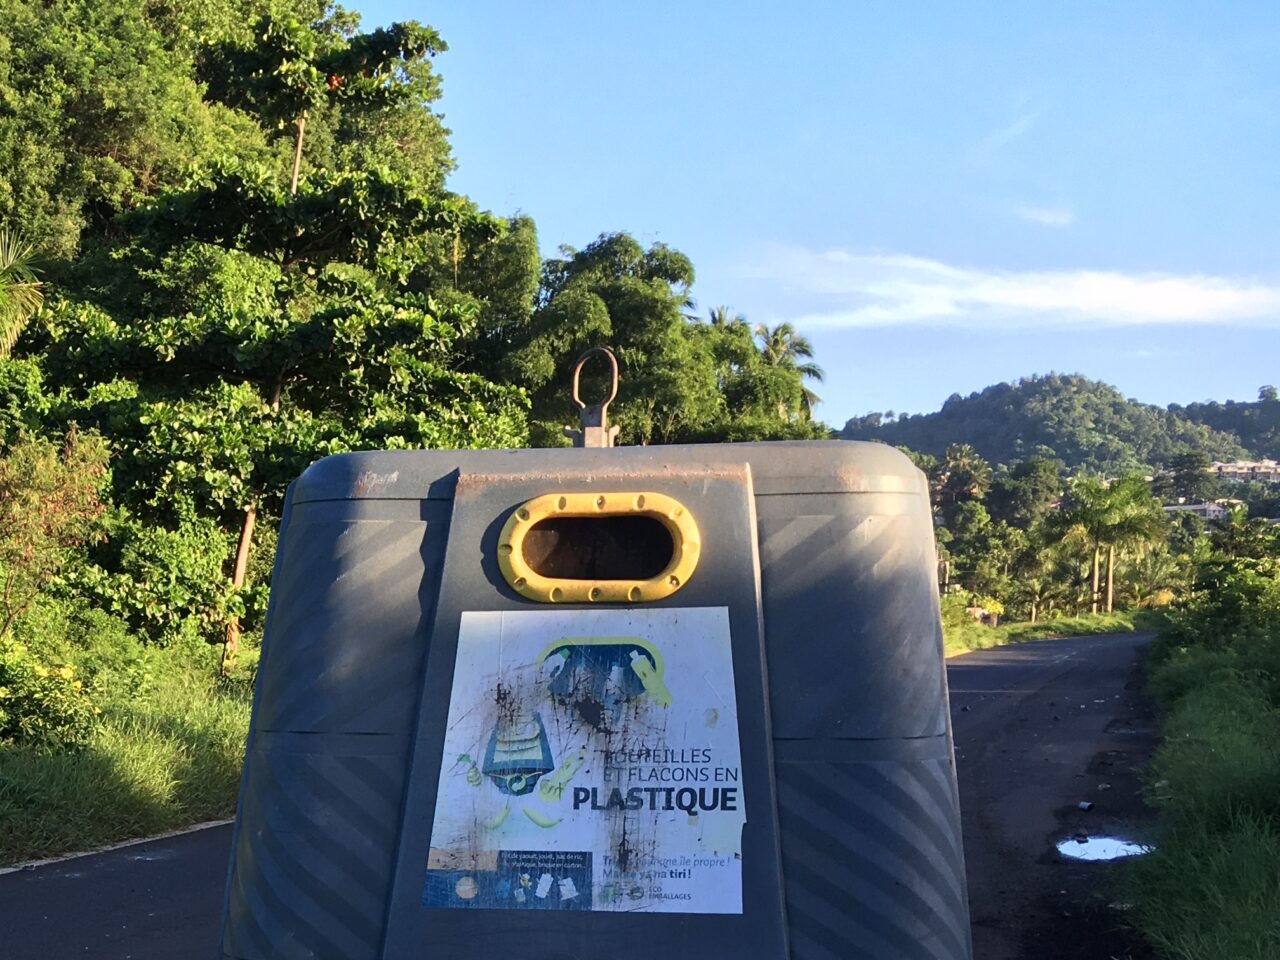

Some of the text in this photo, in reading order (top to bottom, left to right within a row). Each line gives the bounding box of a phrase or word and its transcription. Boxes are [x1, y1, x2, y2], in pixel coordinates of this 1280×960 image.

[604, 767, 739, 782] ET FLACONS EN
[573, 787, 738, 816] PLASTIQUE
